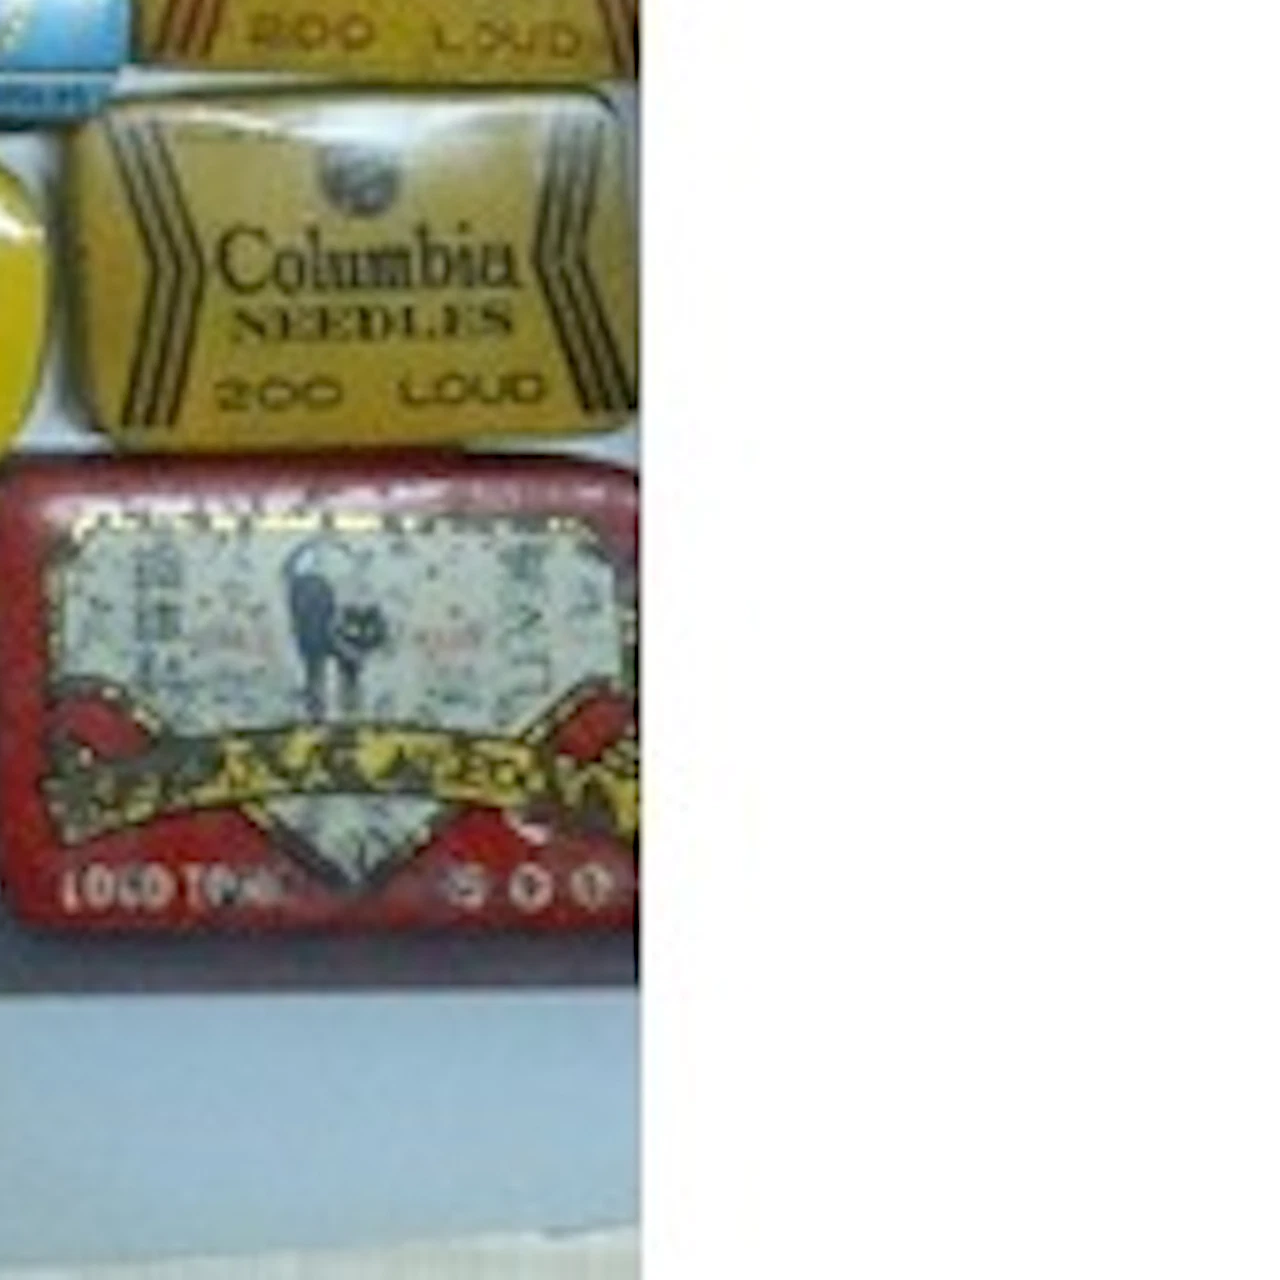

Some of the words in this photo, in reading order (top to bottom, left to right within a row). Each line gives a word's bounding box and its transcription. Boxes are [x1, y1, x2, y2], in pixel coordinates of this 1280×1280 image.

[432, 16, 584, 60] LOUD
[214, 220, 522, 296] Columbia
[233, 300, 516, 342] NEEDLES
[215, 374, 346, 414] 200
[396, 370, 548, 408] LOUD
